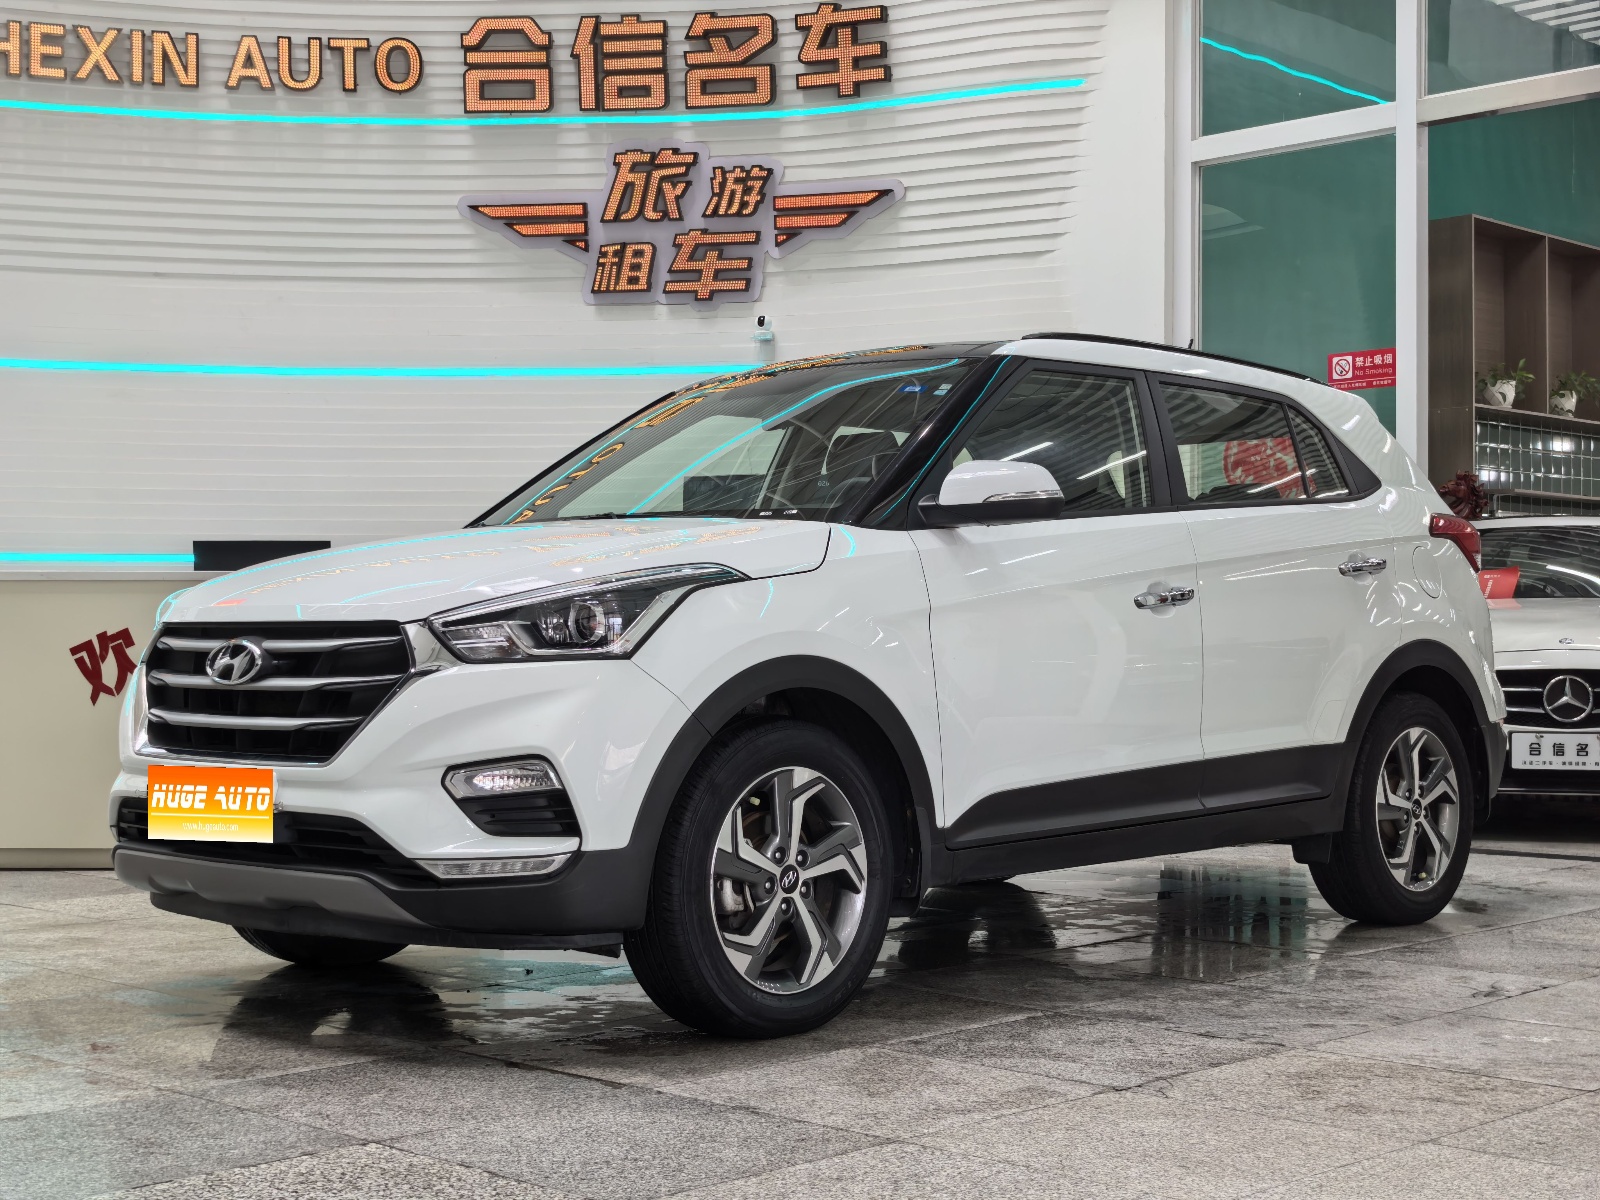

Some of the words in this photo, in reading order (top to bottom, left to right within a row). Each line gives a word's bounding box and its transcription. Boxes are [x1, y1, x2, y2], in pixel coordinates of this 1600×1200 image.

[225, 34, 423, 94] AUTO
[461, 3, 892, 113] 合信名车
[600, 148, 773, 223] 旅游
[591, 228, 761, 301] 租车
[1355, 353, 1393, 368] 禁止吸烟
[1365, 367, 1393, 375] Smoking
[69, 627, 138, 707] 欢
